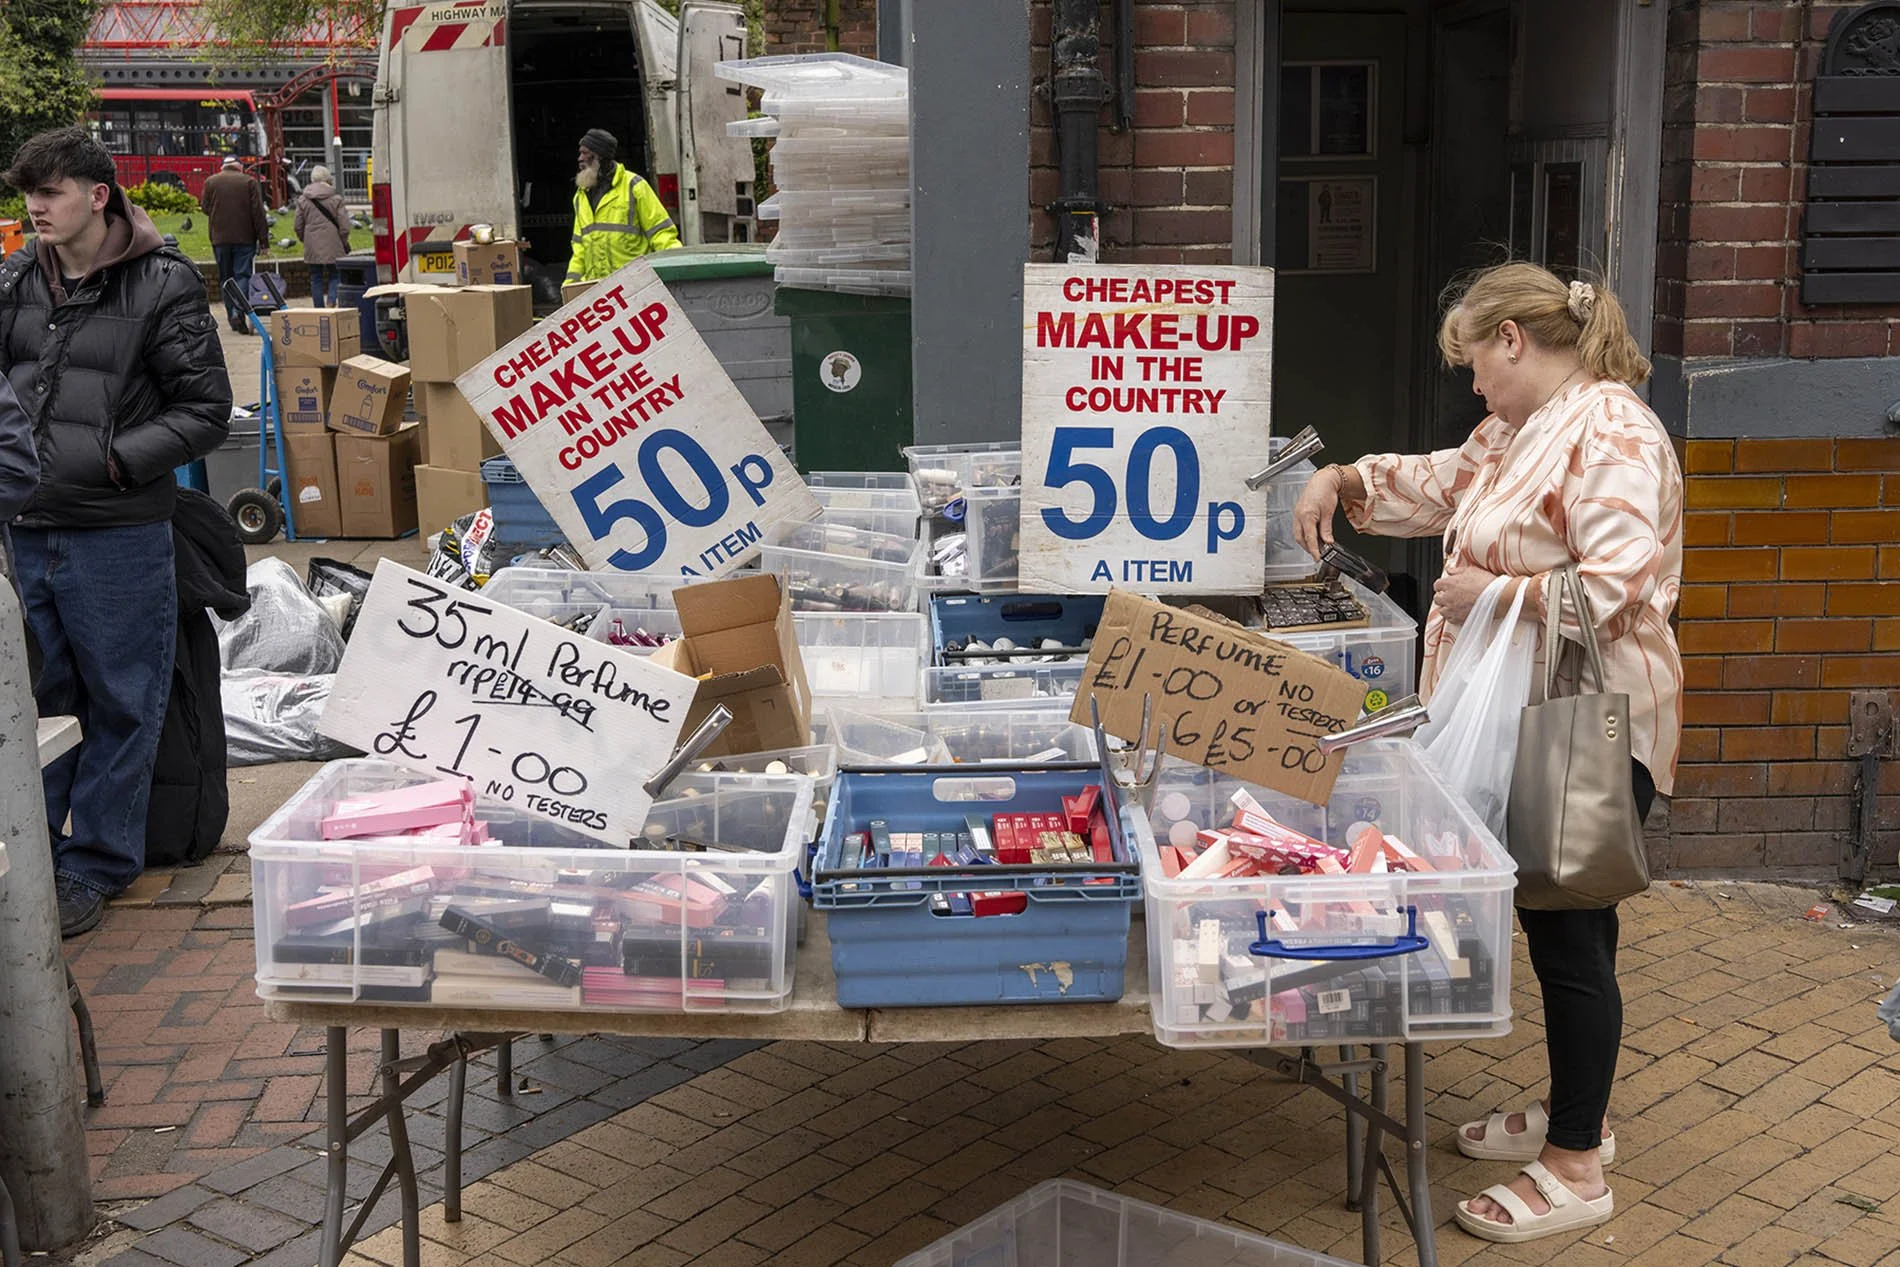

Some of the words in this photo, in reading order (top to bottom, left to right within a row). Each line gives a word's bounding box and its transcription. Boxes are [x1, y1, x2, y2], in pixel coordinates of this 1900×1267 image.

[431, 8, 487, 21] HIGHWAY
[1062, 276, 1237, 305] CHEAPEST
[493, 284, 629, 389] CHEAPEST
[1036, 311, 1260, 352] MAKE-UP
[357, 378, 388, 396] Comfort
[491, 302, 669, 440] MAKE-UP
[1091, 355, 1124, 381] IN
[1135, 356, 1203, 383] THE
[557, 403, 594, 437] IN
[591, 362, 654, 411] THE
[558, 374, 685, 471] COUNTRY
[1064, 385, 1227, 414] COUNTRY
[570, 428, 774, 572] 50p
[1040, 426, 1246, 554] 50p
[699, 520, 764, 572] ITEM
[1091, 560, 1113, 582] A
[1123, 560, 1193, 583] ITEM
[1150, 611, 1287, 677] PERFUME
[547, 641, 671, 723] Perfume
[1279, 679, 1315, 703] NO
[1172, 710, 1201, 747] 6
[1233, 699, 1268, 717] or
[486, 780, 515, 801] NO
[527, 794, 608, 831] TESTERS
